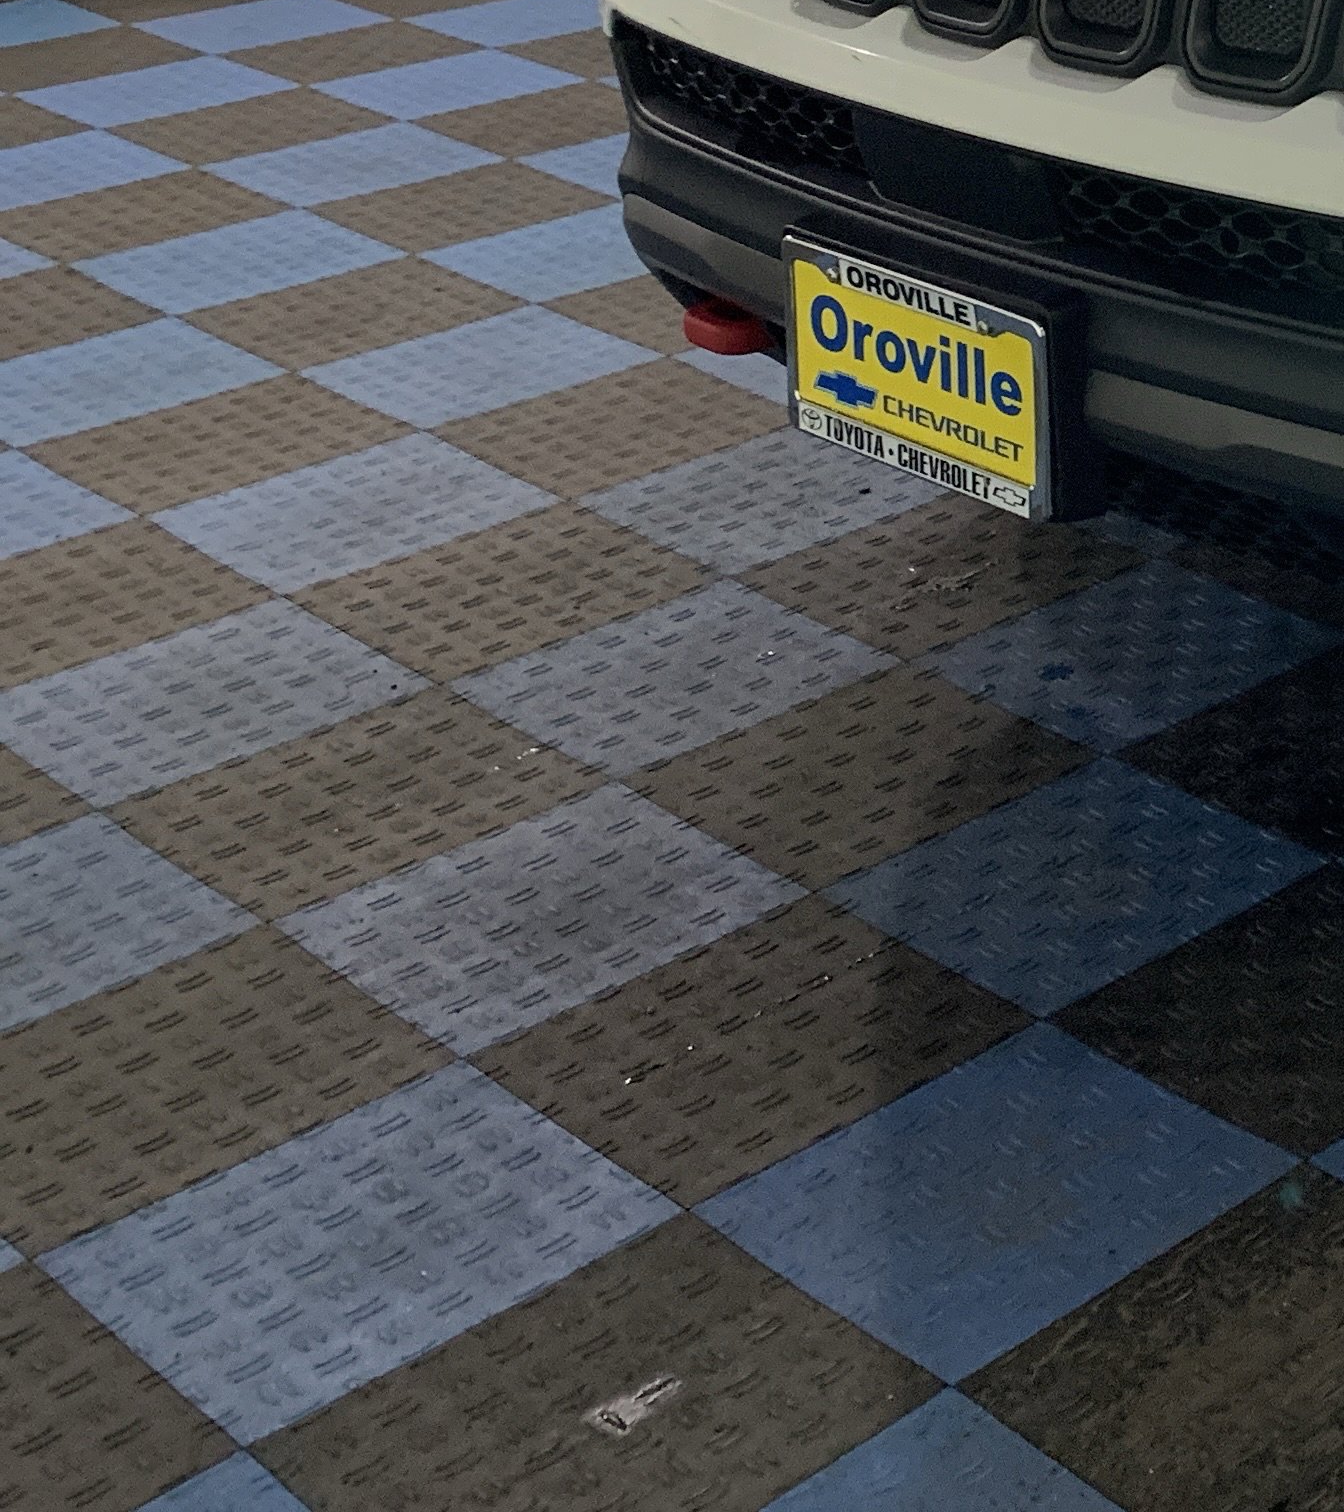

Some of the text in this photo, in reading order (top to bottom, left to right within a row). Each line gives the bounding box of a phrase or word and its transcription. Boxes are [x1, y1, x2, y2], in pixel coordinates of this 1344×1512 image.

[846, 265, 971, 326] OROVILLE
[810, 294, 1023, 416] Oroville
[824, 414, 991, 499] TOYOTA CHEVROLET
[882, 394, 1024, 462] CHEVROLET
